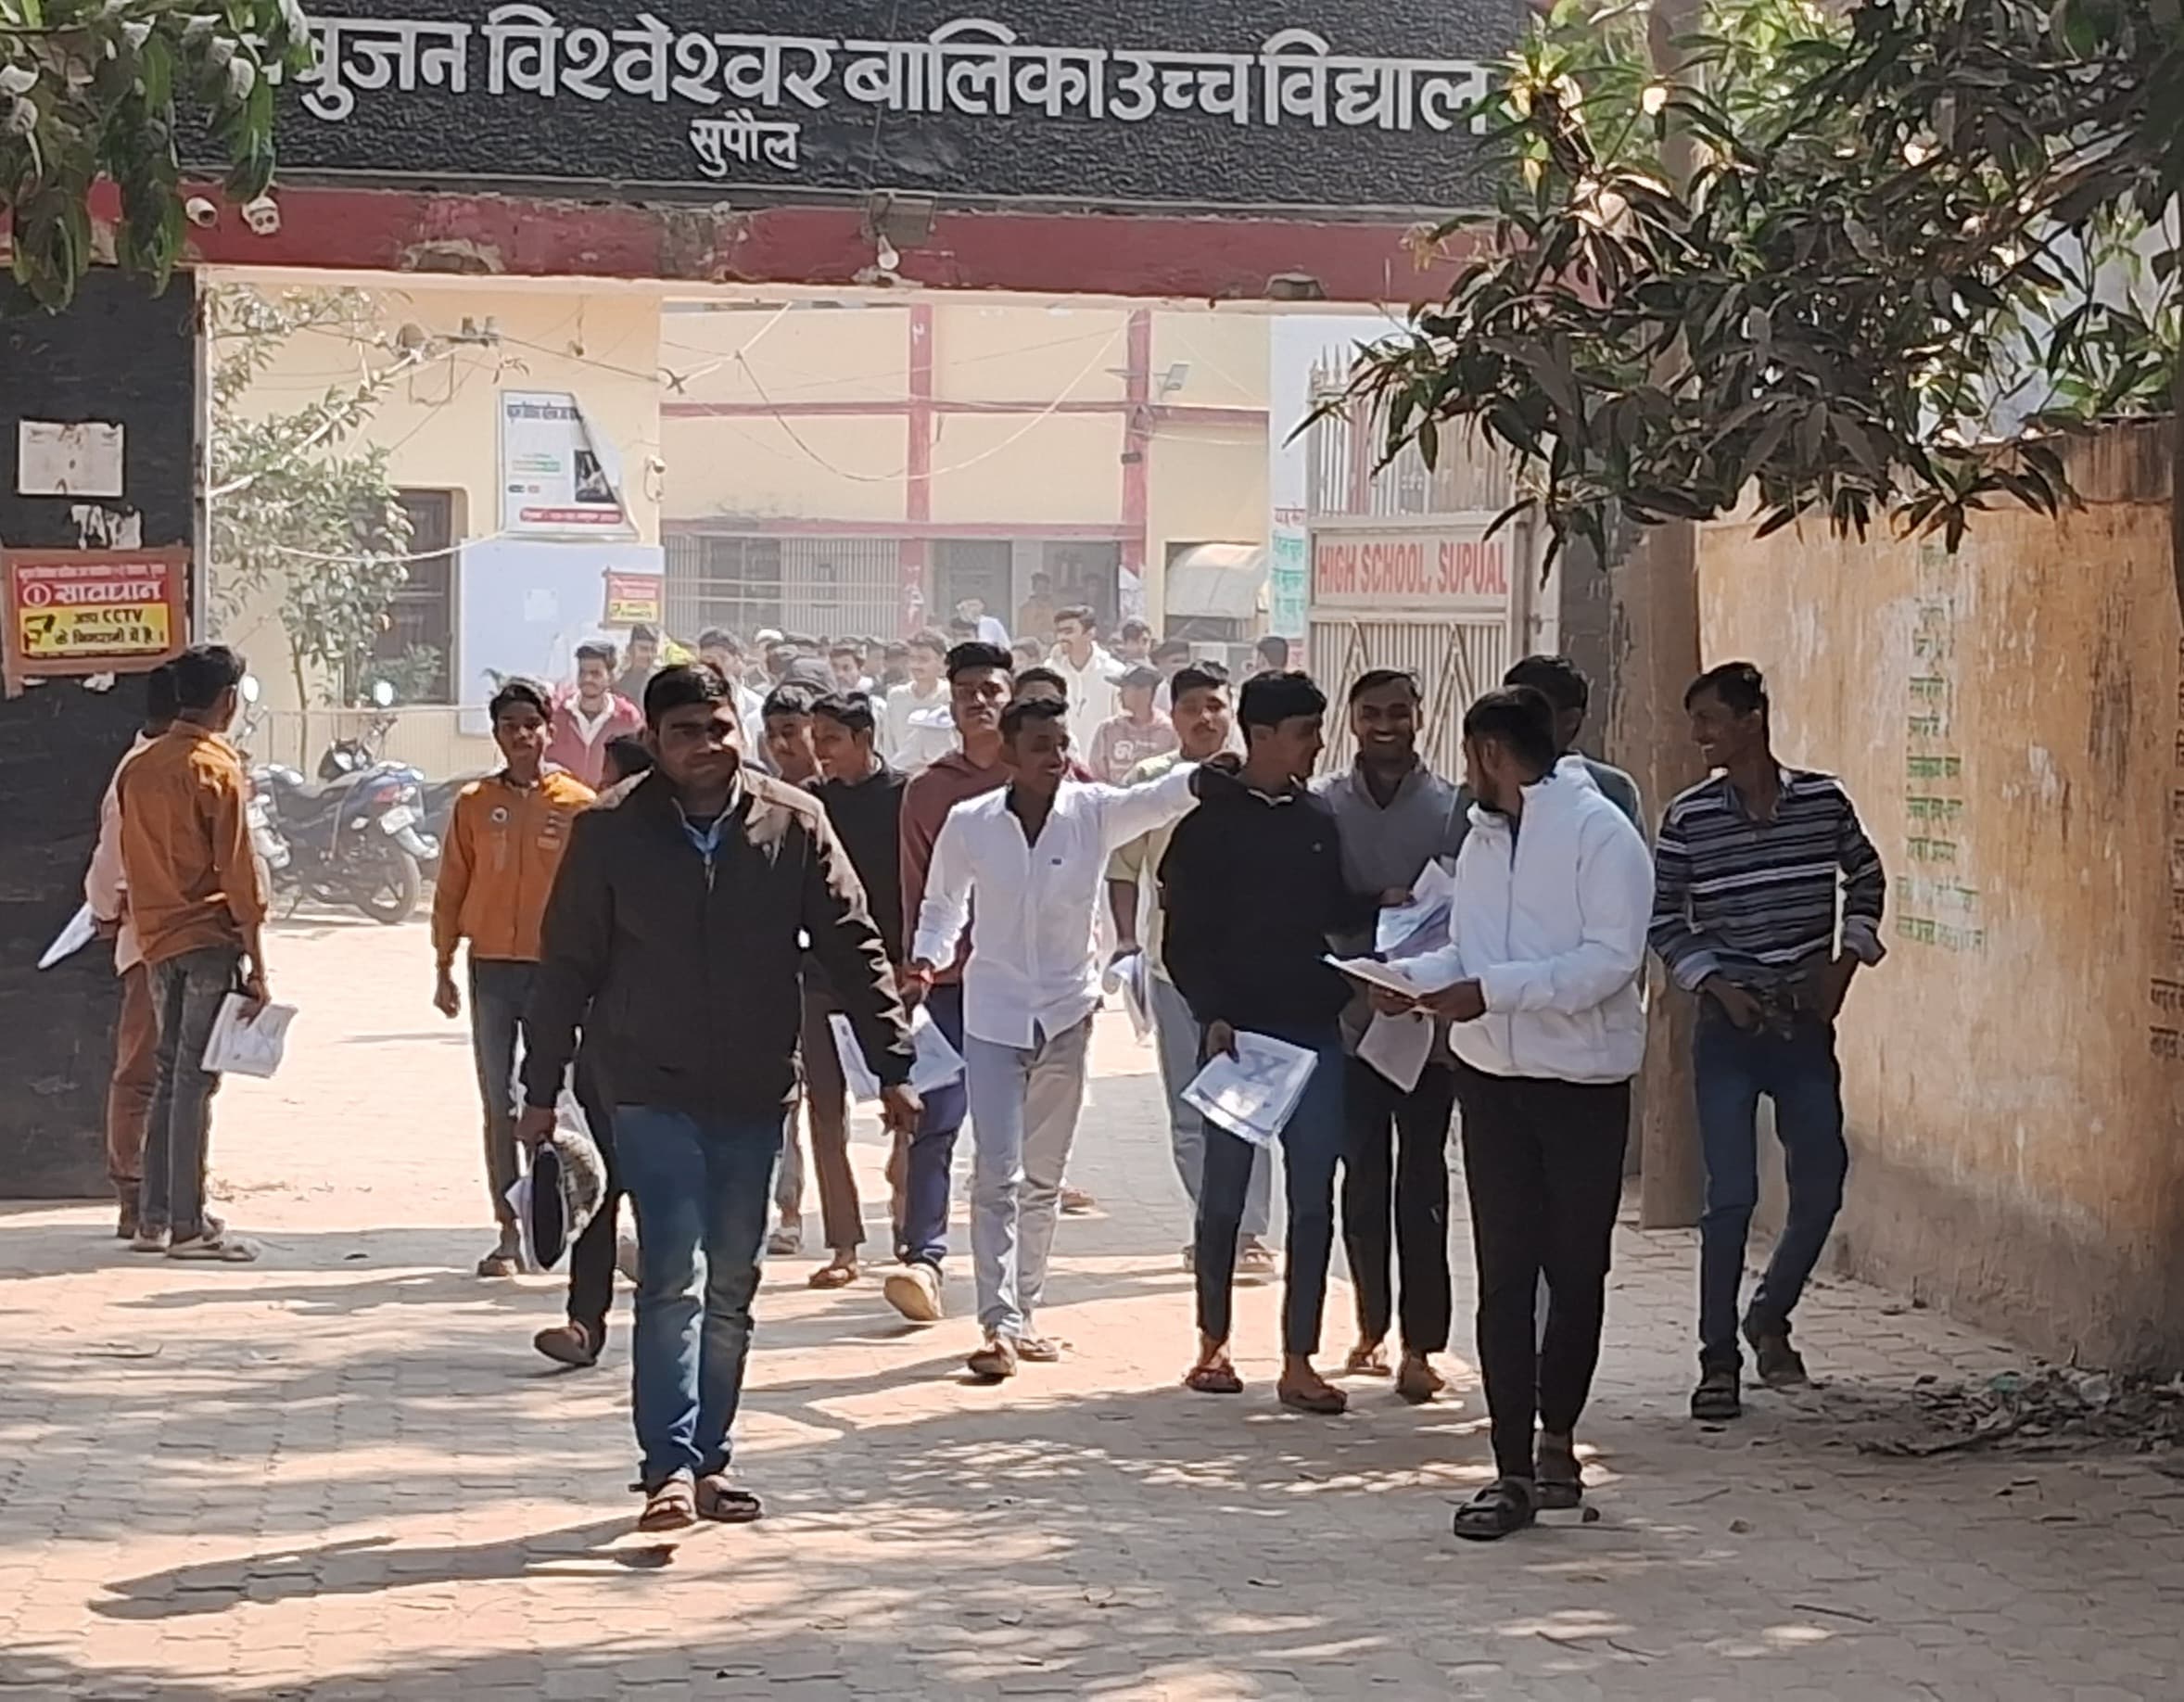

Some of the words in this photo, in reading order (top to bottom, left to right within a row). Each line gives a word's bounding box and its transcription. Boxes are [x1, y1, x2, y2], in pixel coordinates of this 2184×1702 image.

[481, 4, 842, 109] विश्वेश्वर
[843, 18, 1108, 118] बालिका
[1109, 48, 1254, 125] उच्च
[1259, 28, 1496, 135] विद्याल
[689, 108, 801, 177] सुपौल
[1317, 543, 1357, 595] HIGH
[1438, 540, 1508, 596] SUPUAL
[102, 607, 144, 625] CCTV
